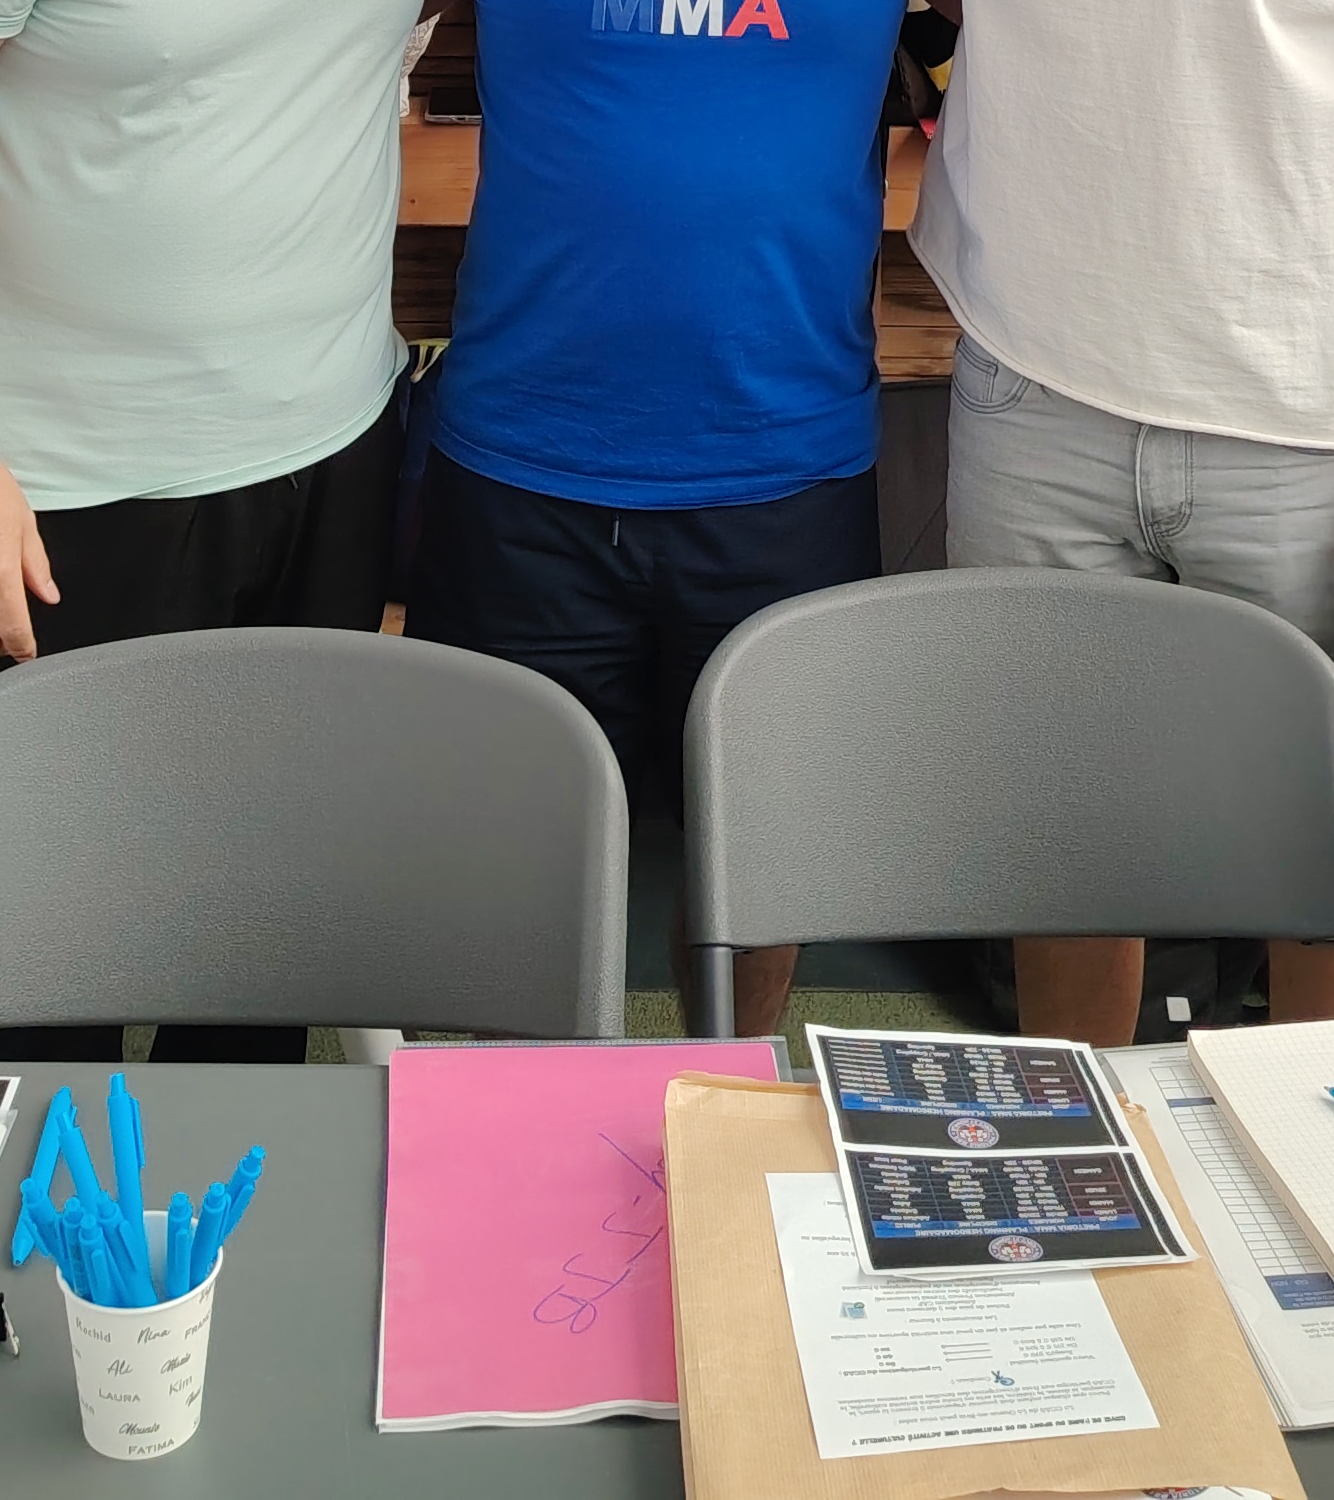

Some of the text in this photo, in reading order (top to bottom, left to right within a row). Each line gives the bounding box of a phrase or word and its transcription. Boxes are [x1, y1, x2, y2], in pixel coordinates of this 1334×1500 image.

[169, 1375, 193, 1396] Kim
[98, 1388, 140, 1403] LAURA
[128, 1438, 175, 1455] FATIMA
